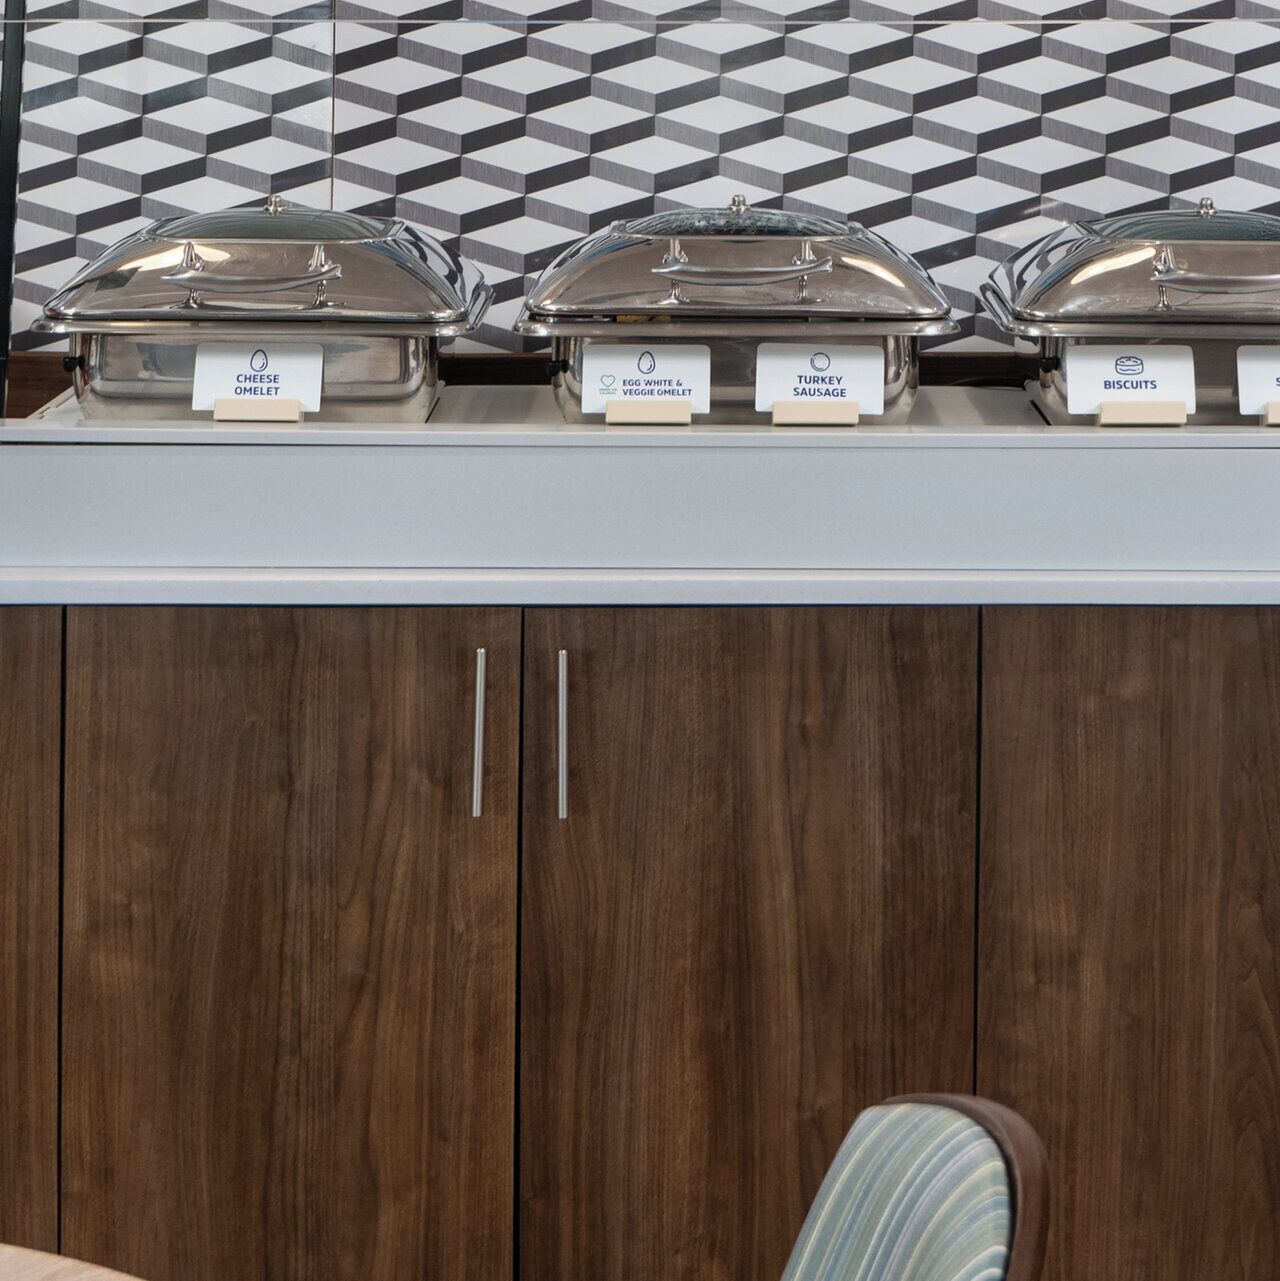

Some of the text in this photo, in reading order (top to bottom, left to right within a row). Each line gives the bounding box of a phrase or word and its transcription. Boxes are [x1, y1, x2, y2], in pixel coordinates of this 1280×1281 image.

[236, 374, 280, 384] CHEESE
[622, 379, 683, 387] EGG WHITE &
[797, 375, 843, 385] TURKEY
[1103, 379, 1158, 391] BISCUITS
[234, 386, 280, 396] OMELET
[622, 388, 655, 396] VEGGIE
[657, 388, 693, 396] OMELET
[793, 387, 847, 398] SAUSAGE
